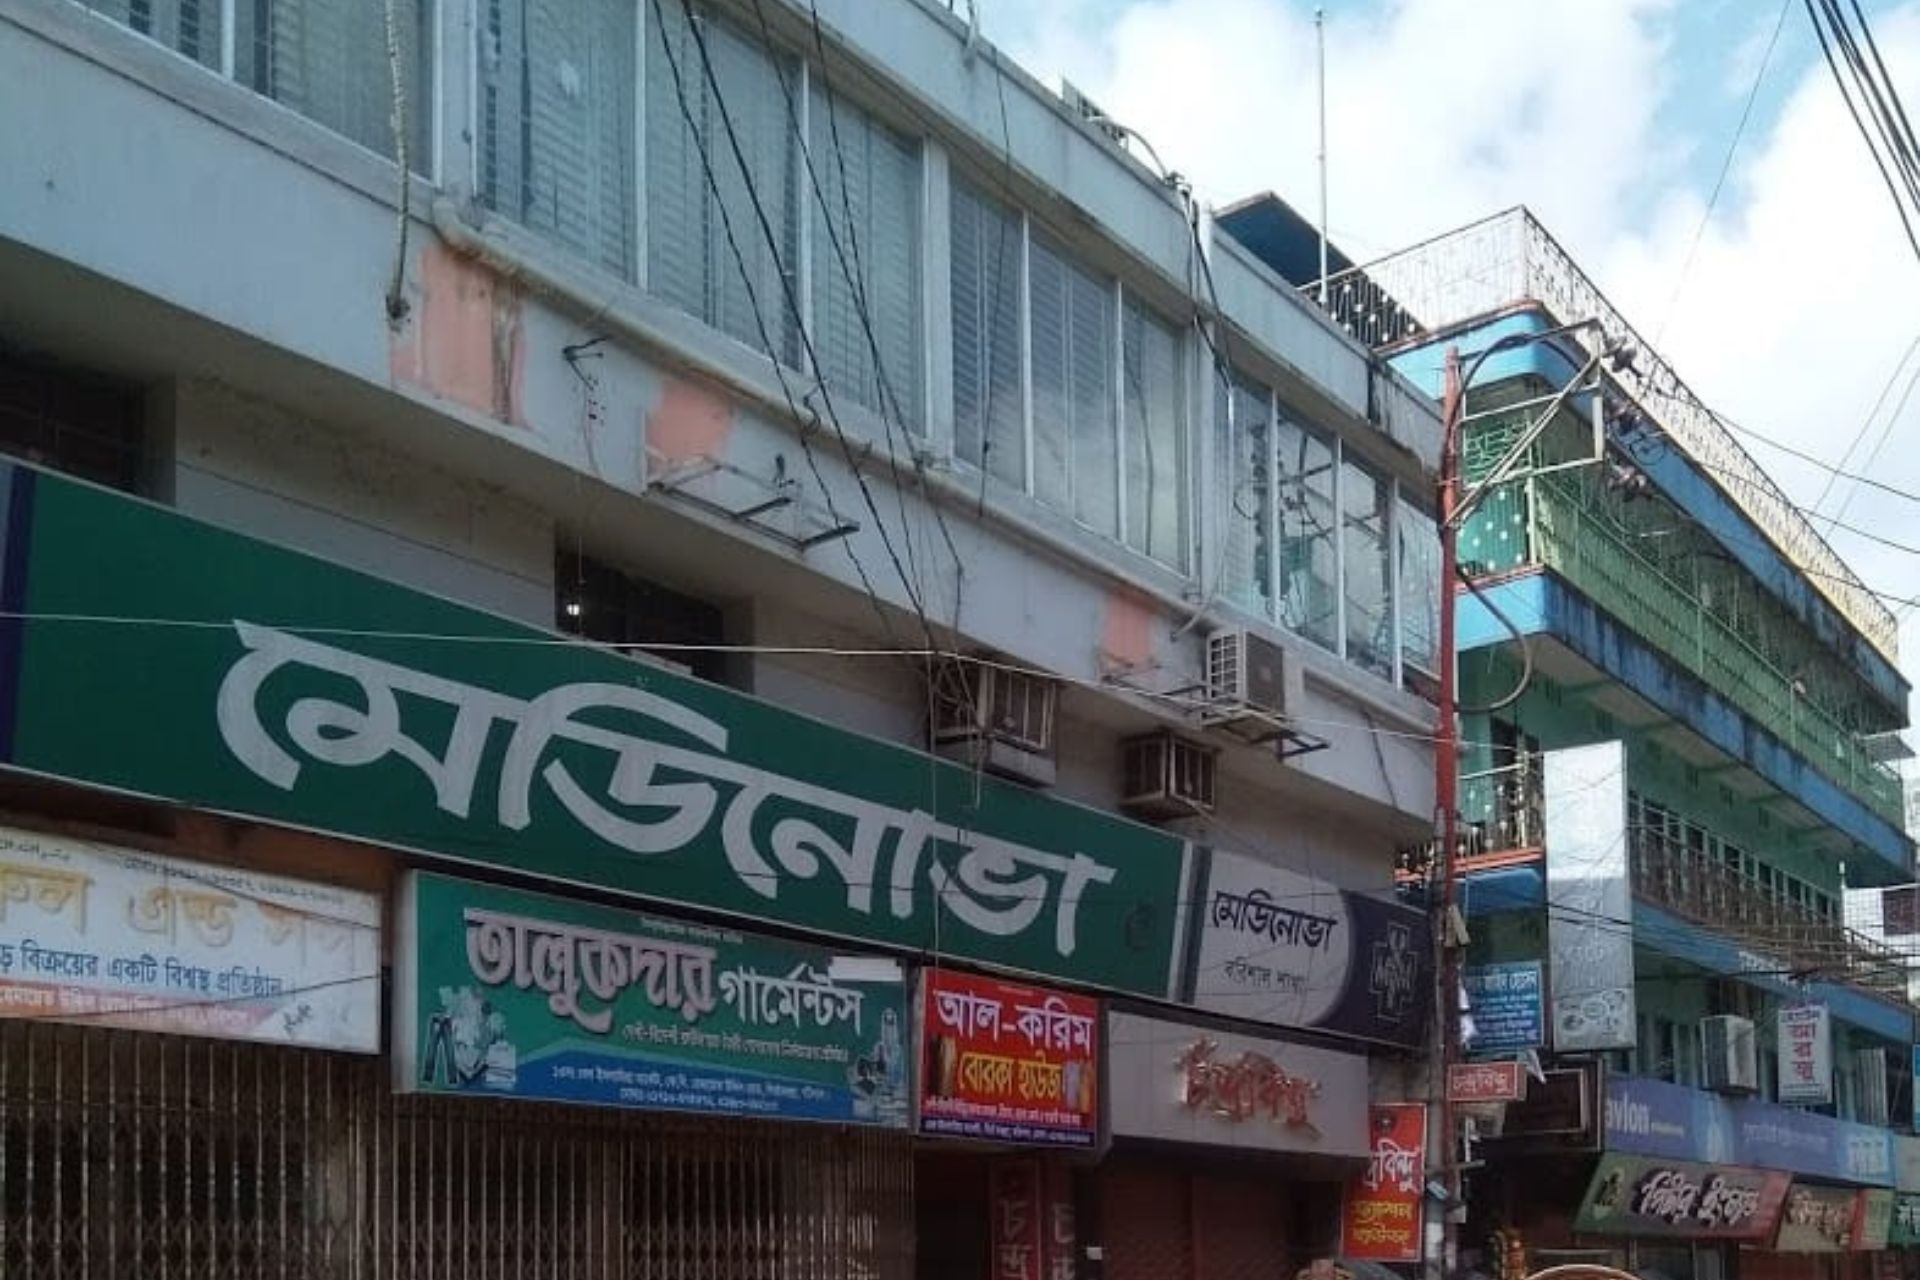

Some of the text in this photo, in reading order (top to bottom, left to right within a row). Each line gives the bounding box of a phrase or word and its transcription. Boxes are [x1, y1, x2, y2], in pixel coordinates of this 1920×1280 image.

[215, 619, 1117, 957] মেডিনোভা
[1211, 887, 1339, 954] মেডিনোভা
[20, 938, 99, 979] বিক্রয়ের
[107, 953, 158, 984] একটি
[464, 907, 866, 1036] তালুকদার গার্মেন্টস
[932, 988, 1095, 1060] আল-করিম
[957, 1050, 1014, 1097] বোরকা
